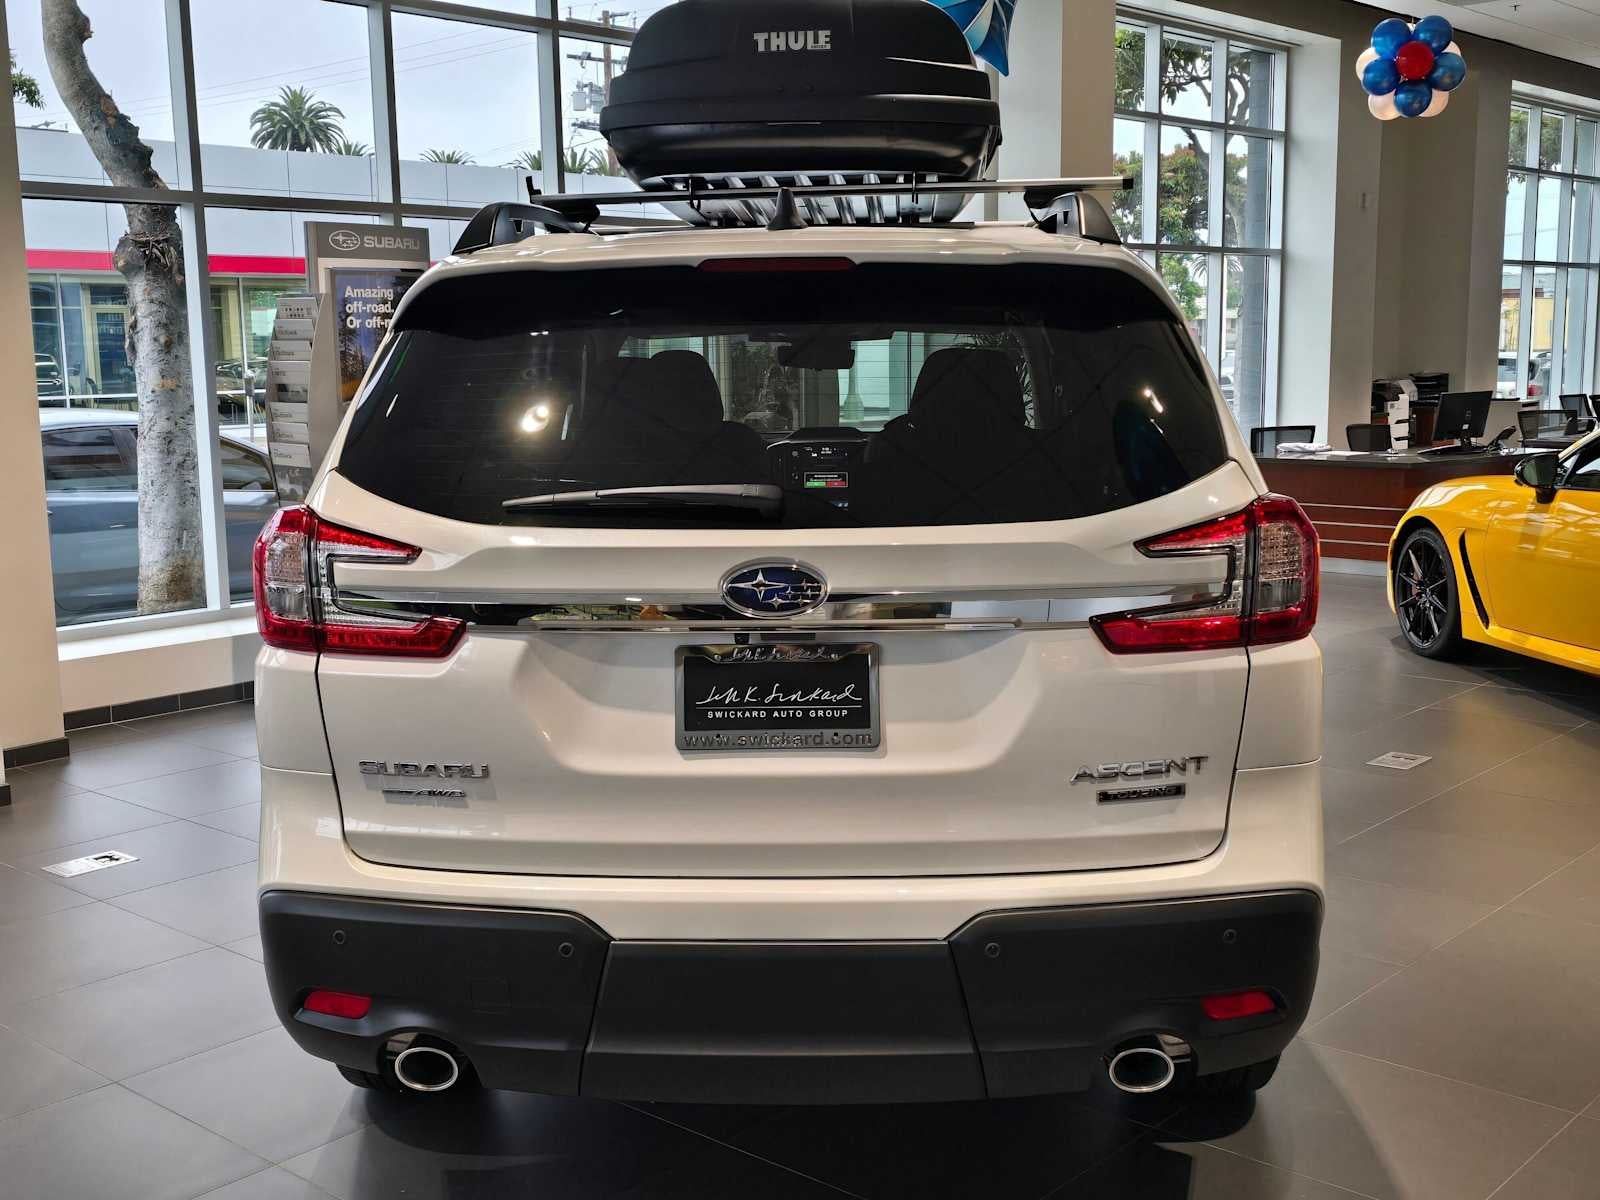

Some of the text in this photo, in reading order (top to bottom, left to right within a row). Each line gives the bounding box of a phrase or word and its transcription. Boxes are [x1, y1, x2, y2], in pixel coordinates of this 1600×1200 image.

[753, 30, 831, 52] THULE
[363, 235, 420, 249] SUBARU
[344, 286, 394, 300] Amazing
[345, 301, 395, 313] off-road.
[346, 316, 361, 328] Or
[707, 709, 849, 719] SWICKARD AUTO GROUP
[683, 731, 872, 747] www.swickard.com
[359, 760, 490, 779] SUBARU
[1069, 755, 1209, 785] ASCENT
